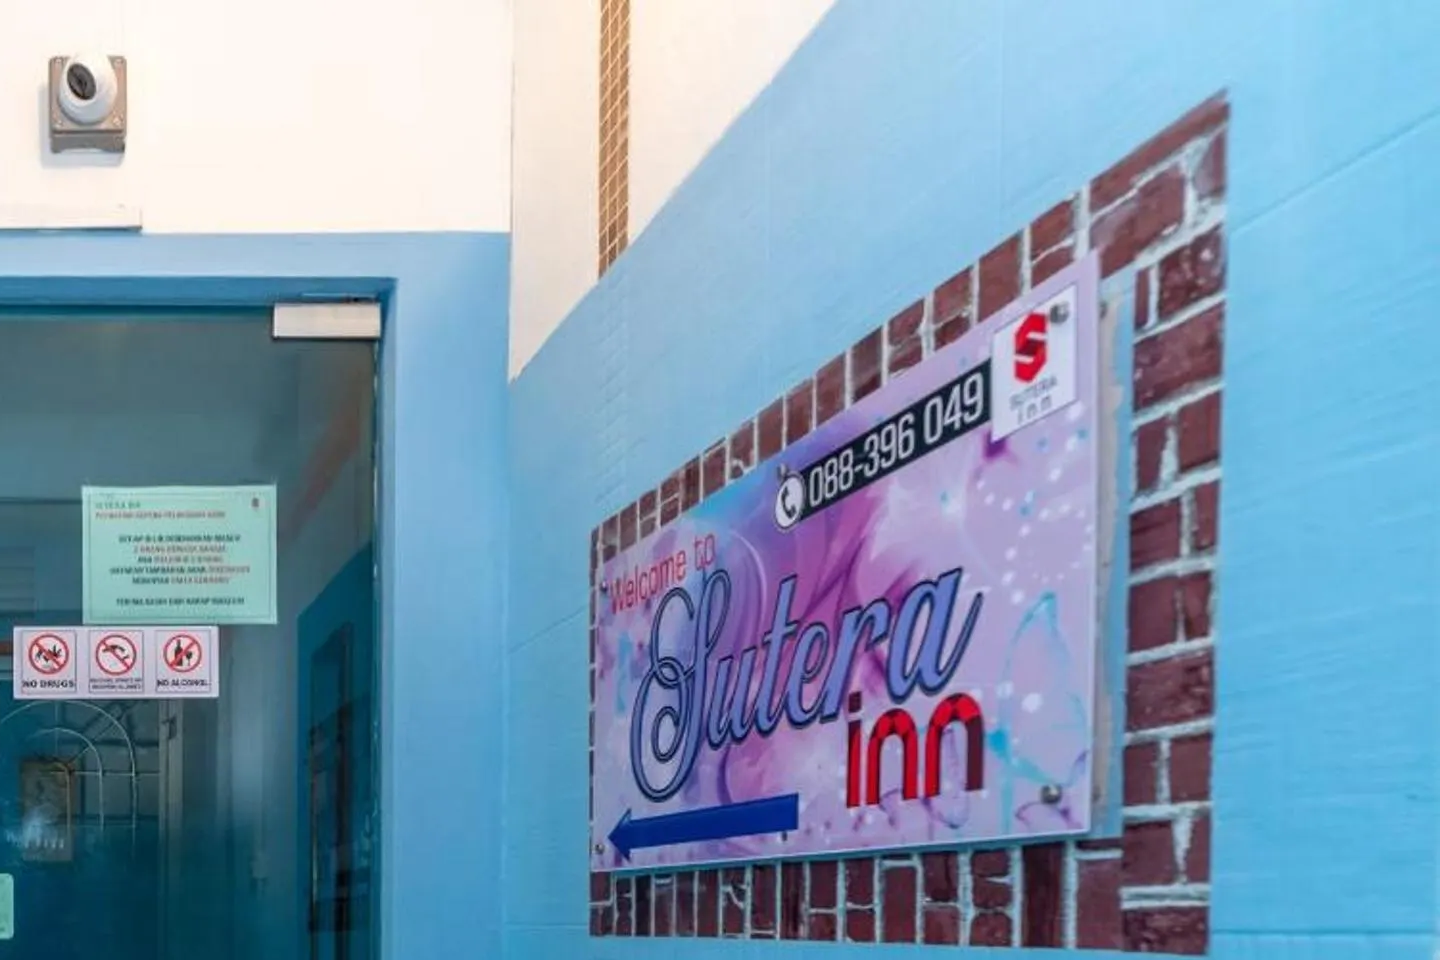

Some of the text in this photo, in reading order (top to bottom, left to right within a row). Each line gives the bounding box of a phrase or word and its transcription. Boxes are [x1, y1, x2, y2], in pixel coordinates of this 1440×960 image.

[808, 371, 985, 507] 088-396 049
[610, 533, 716, 615] Welcome to
[40, 680, 75, 689] DRUGS
[631, 565, 983, 803] Sutera
[846, 691, 985, 809] inn
